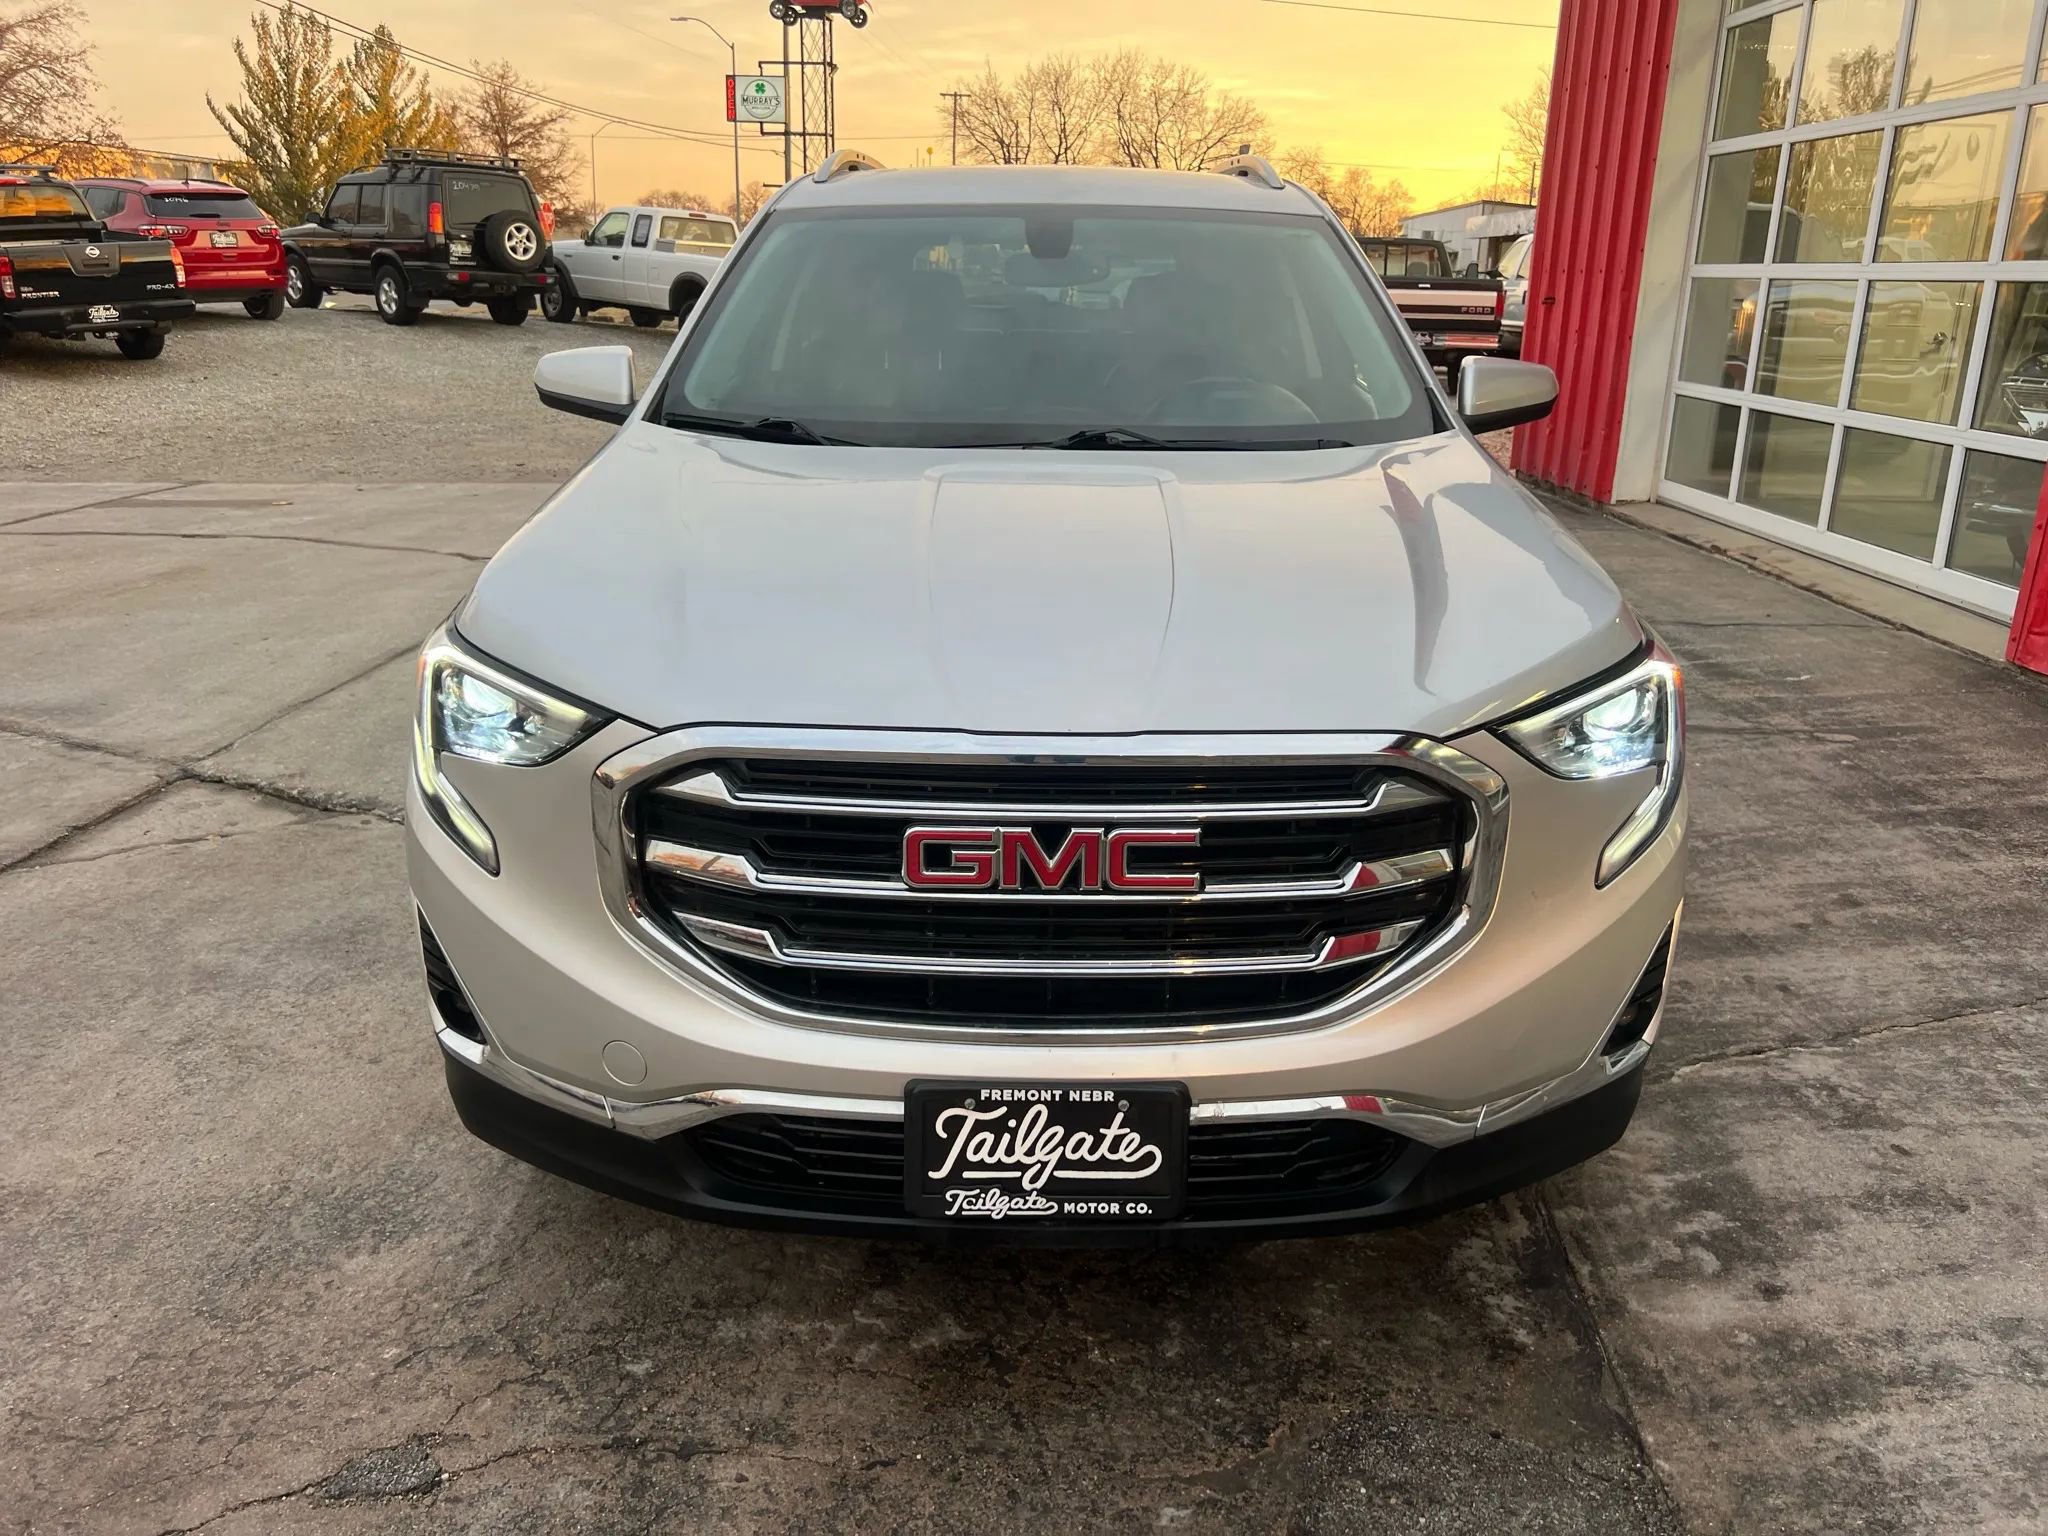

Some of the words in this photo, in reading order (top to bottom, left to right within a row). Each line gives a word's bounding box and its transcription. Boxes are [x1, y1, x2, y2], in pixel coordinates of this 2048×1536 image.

[727, 79, 735, 120] OPEN
[742, 96, 780, 106] MURRAY'S
[21, 291, 60, 299] FRONTIER
[1461, 306, 1492, 314] FORD
[902, 825, 1201, 892] GMC
[980, 1089, 1062, 1102] FREMONT
[1069, 1090, 1114, 1102] NEBR
[928, 1103, 1163, 1191] Tailgate
[945, 1188, 1058, 1219] Tailgate
[1063, 1202, 1120, 1214] MOTOR
[1125, 1202, 1153, 1215] CO.
